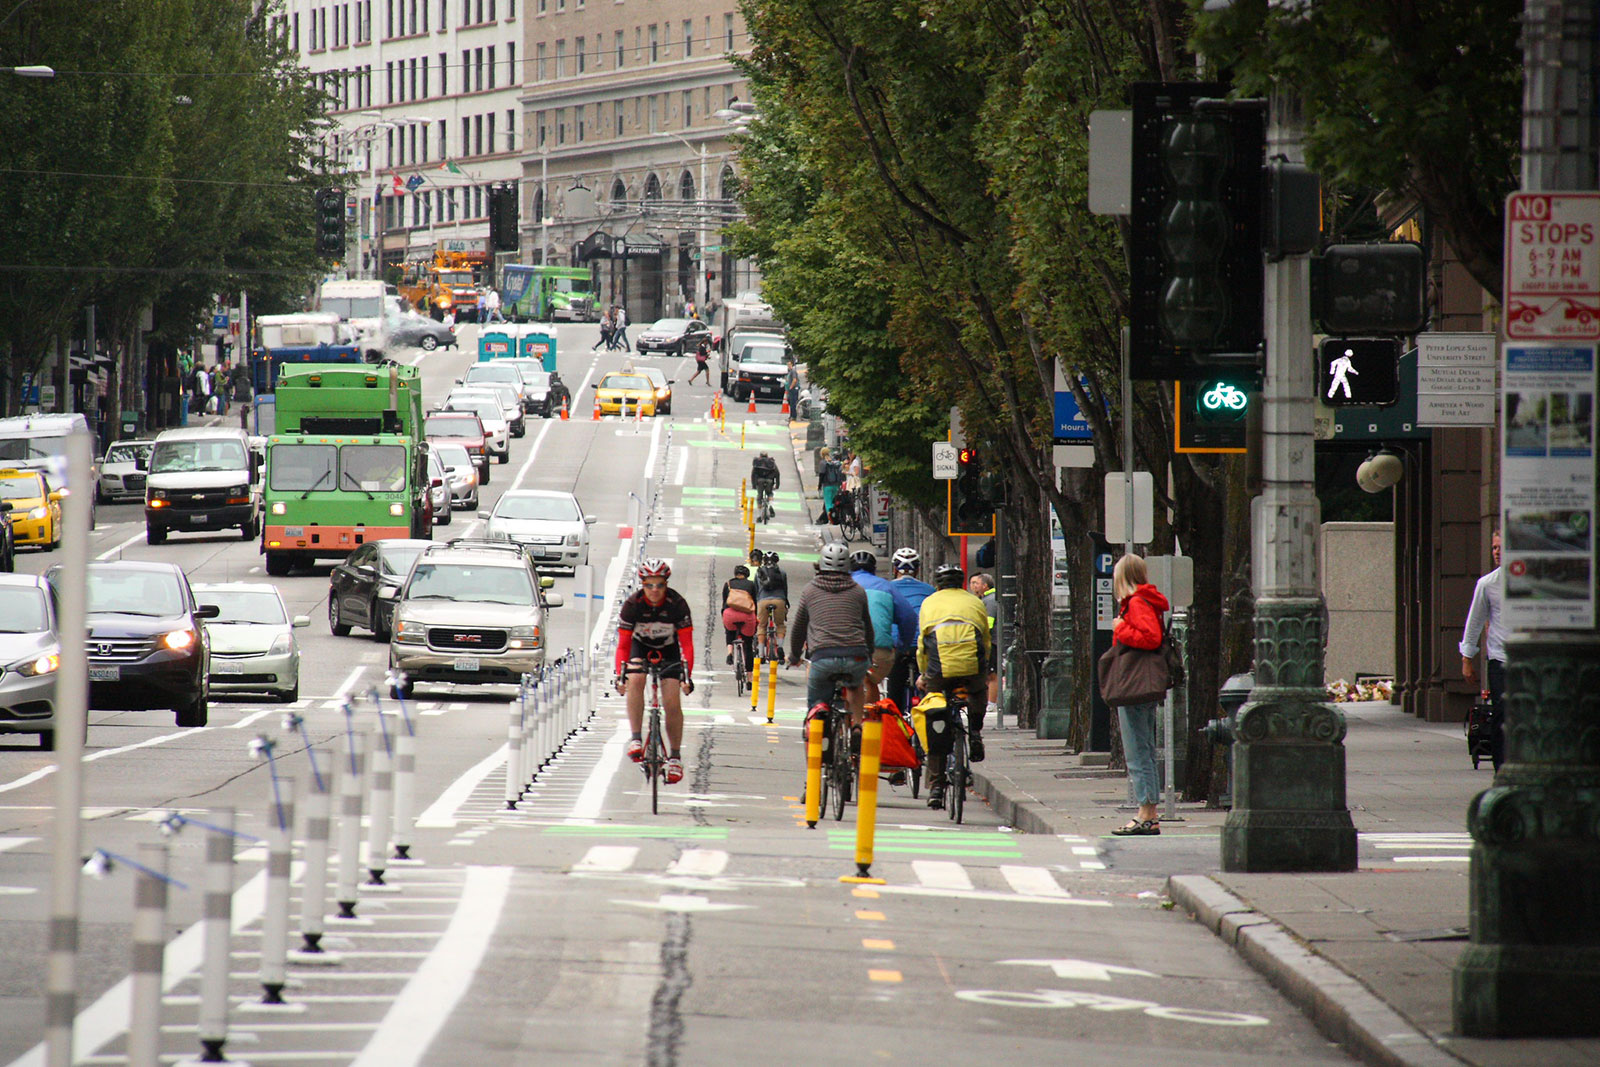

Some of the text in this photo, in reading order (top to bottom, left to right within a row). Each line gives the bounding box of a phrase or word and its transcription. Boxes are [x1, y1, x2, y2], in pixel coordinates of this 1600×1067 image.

[1515, 198, 1547, 218] NO
[1521, 222, 1594, 244] STOPS
[1562, 248, 1582, 261] AM
[1562, 264, 1581, 278] PM
[1060, 423, 1085, 431] Hours
[1101, 553, 1113, 573] P
[453, 634, 482, 642] GMC
